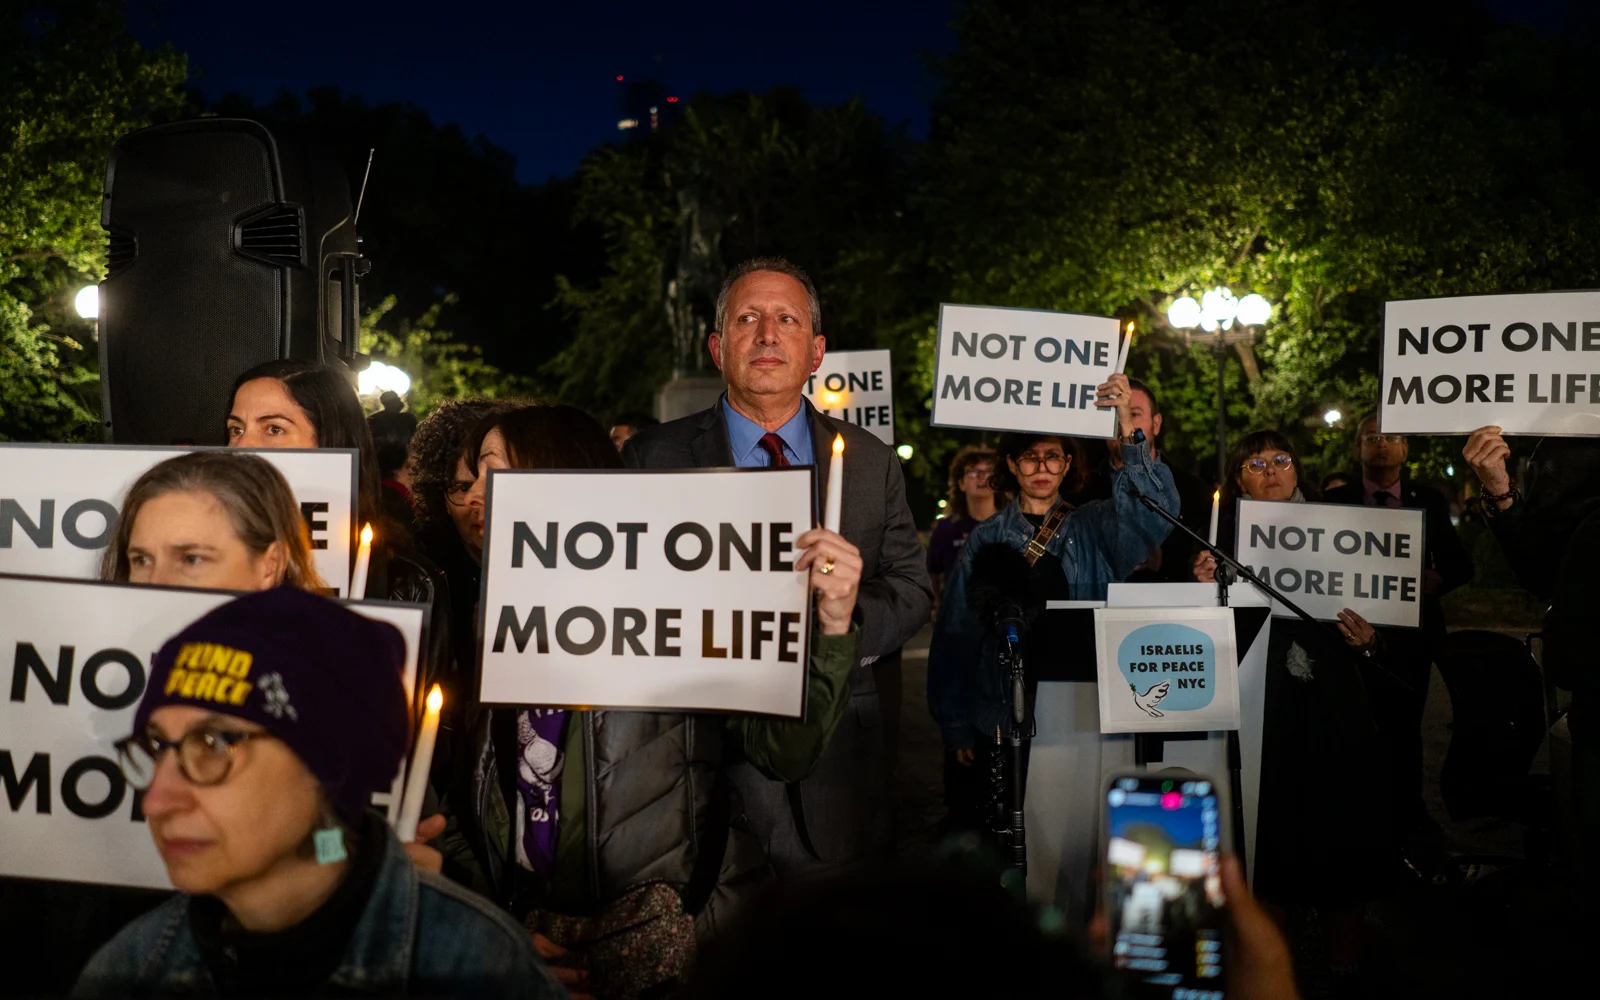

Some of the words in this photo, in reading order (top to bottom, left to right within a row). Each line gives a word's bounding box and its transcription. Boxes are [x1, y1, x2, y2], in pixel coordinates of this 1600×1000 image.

[952, 331, 1026, 360] NOT
[1034, 337, 1109, 367] ONE
[1398, 324, 1490, 355] NOT
[1502, 322, 1600, 352] ONE
[825, 370, 883, 392] ONE
[940, 374, 1043, 406] MORE
[1387, 374, 1514, 405] MORE
[0, 498, 122, 550] NO
[511, 521, 648, 571] NOT
[664, 522, 793, 572] ONE
[1250, 524, 1325, 552] NOT
[1333, 529, 1411, 559] ONE
[1354, 573, 1416, 602] LIFE
[491, 605, 682, 656] MORE
[701, 609, 801, 664] LIFE
[1141, 644, 1203, 655] ISRAELIS
[10, 642, 156, 710] NO
[174, 642, 254, 679] FUND
[1130, 662, 1158, 673] FOR
[1162, 661, 1204, 672] PEACE
[164, 668, 253, 706] PEACE
[1178, 678, 1205, 689] NYC
